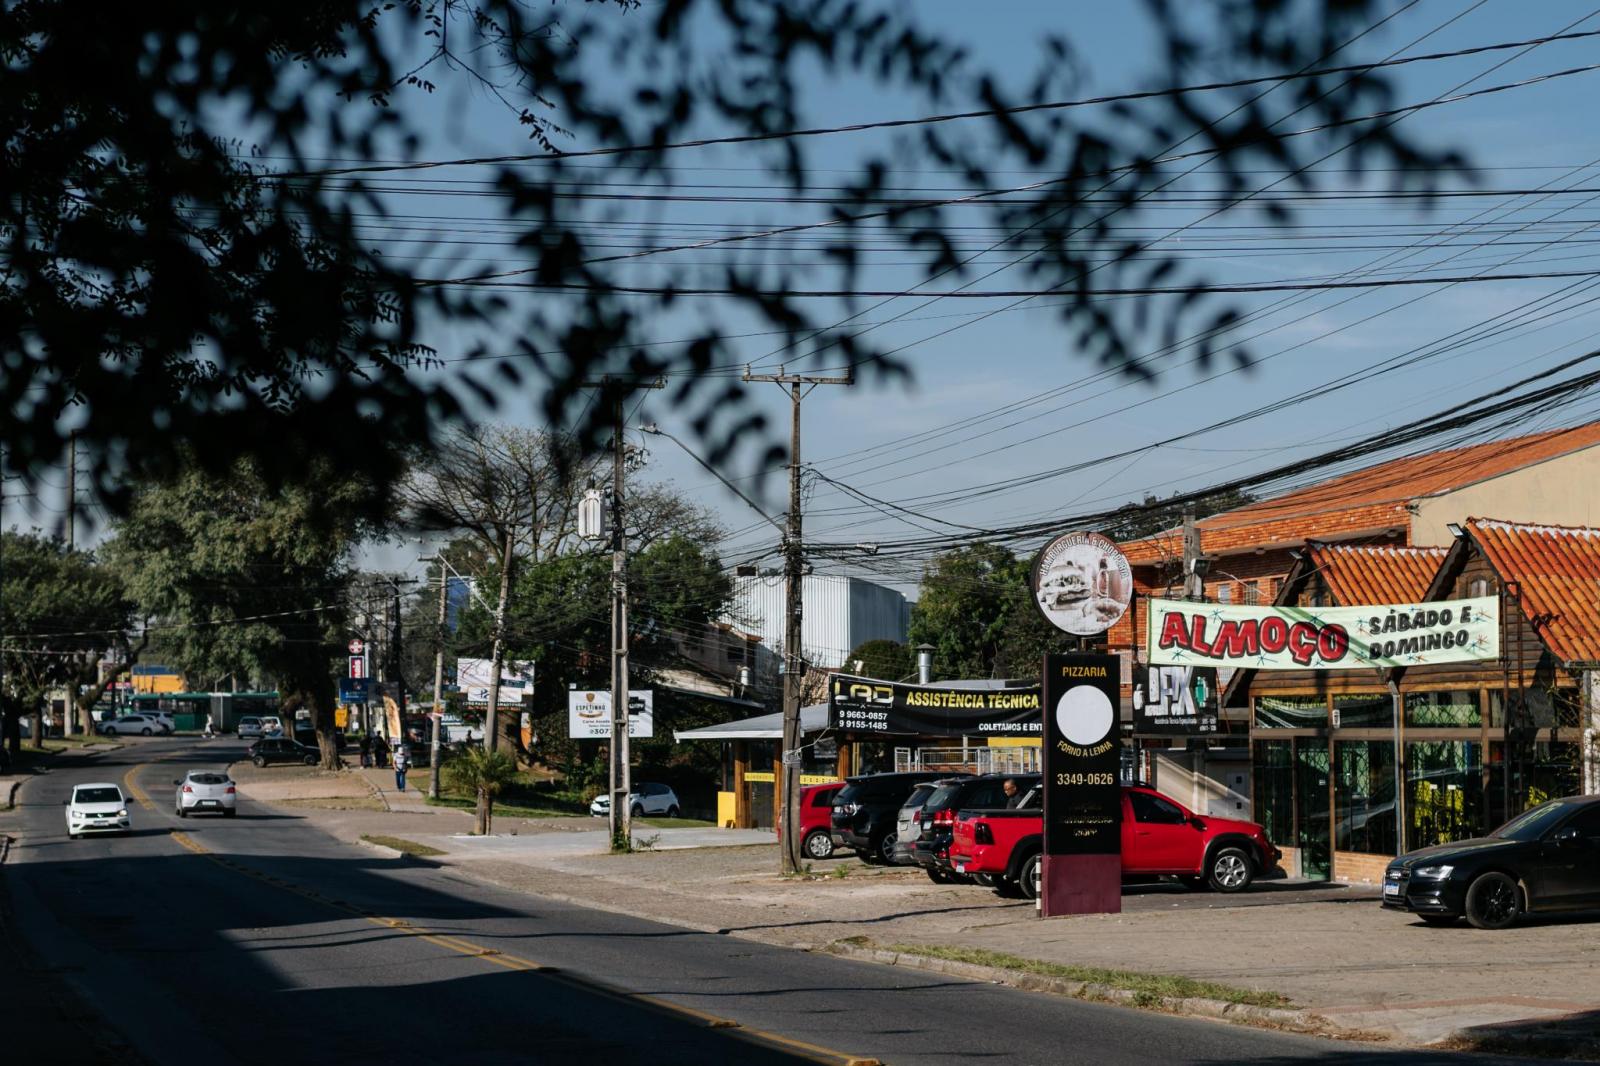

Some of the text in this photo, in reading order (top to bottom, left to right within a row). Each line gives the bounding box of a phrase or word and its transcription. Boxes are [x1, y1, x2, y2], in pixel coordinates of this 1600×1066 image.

[1369, 606, 1472, 635] SÁBADO E
[1158, 611, 1350, 666] ALMOÇO
[1369, 629, 1469, 659] DOMINGO
[1062, 666, 1107, 677] PIZZARIA
[906, 691, 1040, 708] ASSISTÊNCIA TÉCNICA
[839, 710, 888, 720] 9 9663-0857
[845, 720, 888, 730] 9155-1485
[978, 723, 1021, 731] COLETAMOS
[1023, 723, 1028, 731] E
[1057, 740, 1113, 757] FORNO A LENHA
[1057, 773, 1114, 785] 3349-0626
